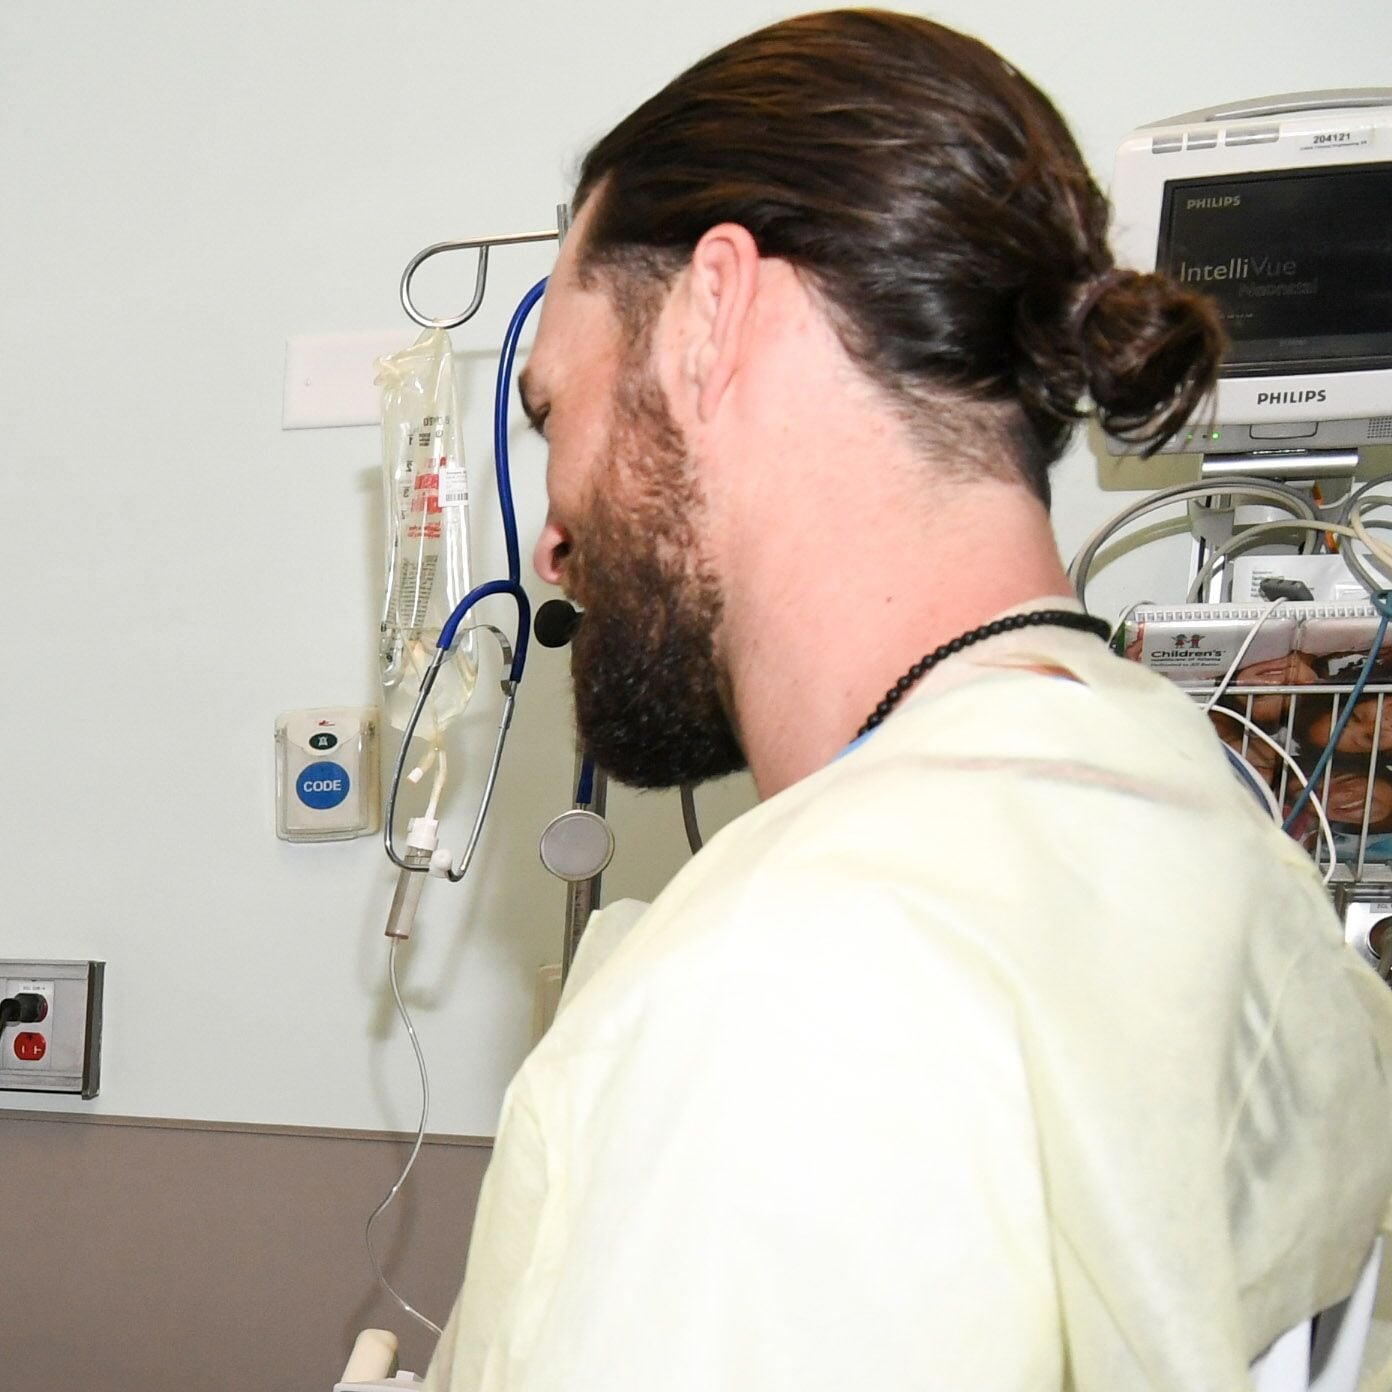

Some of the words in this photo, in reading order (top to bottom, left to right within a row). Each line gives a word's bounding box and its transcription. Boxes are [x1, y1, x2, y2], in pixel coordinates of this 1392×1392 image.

[1313, 133, 1351, 144] 204121
[1187, 196, 1241, 210] PHILIPS
[1257, 389, 1326, 405] PHILIPS
[1151, 649, 1223, 658] Children's
[303, 779, 342, 792] CODE
